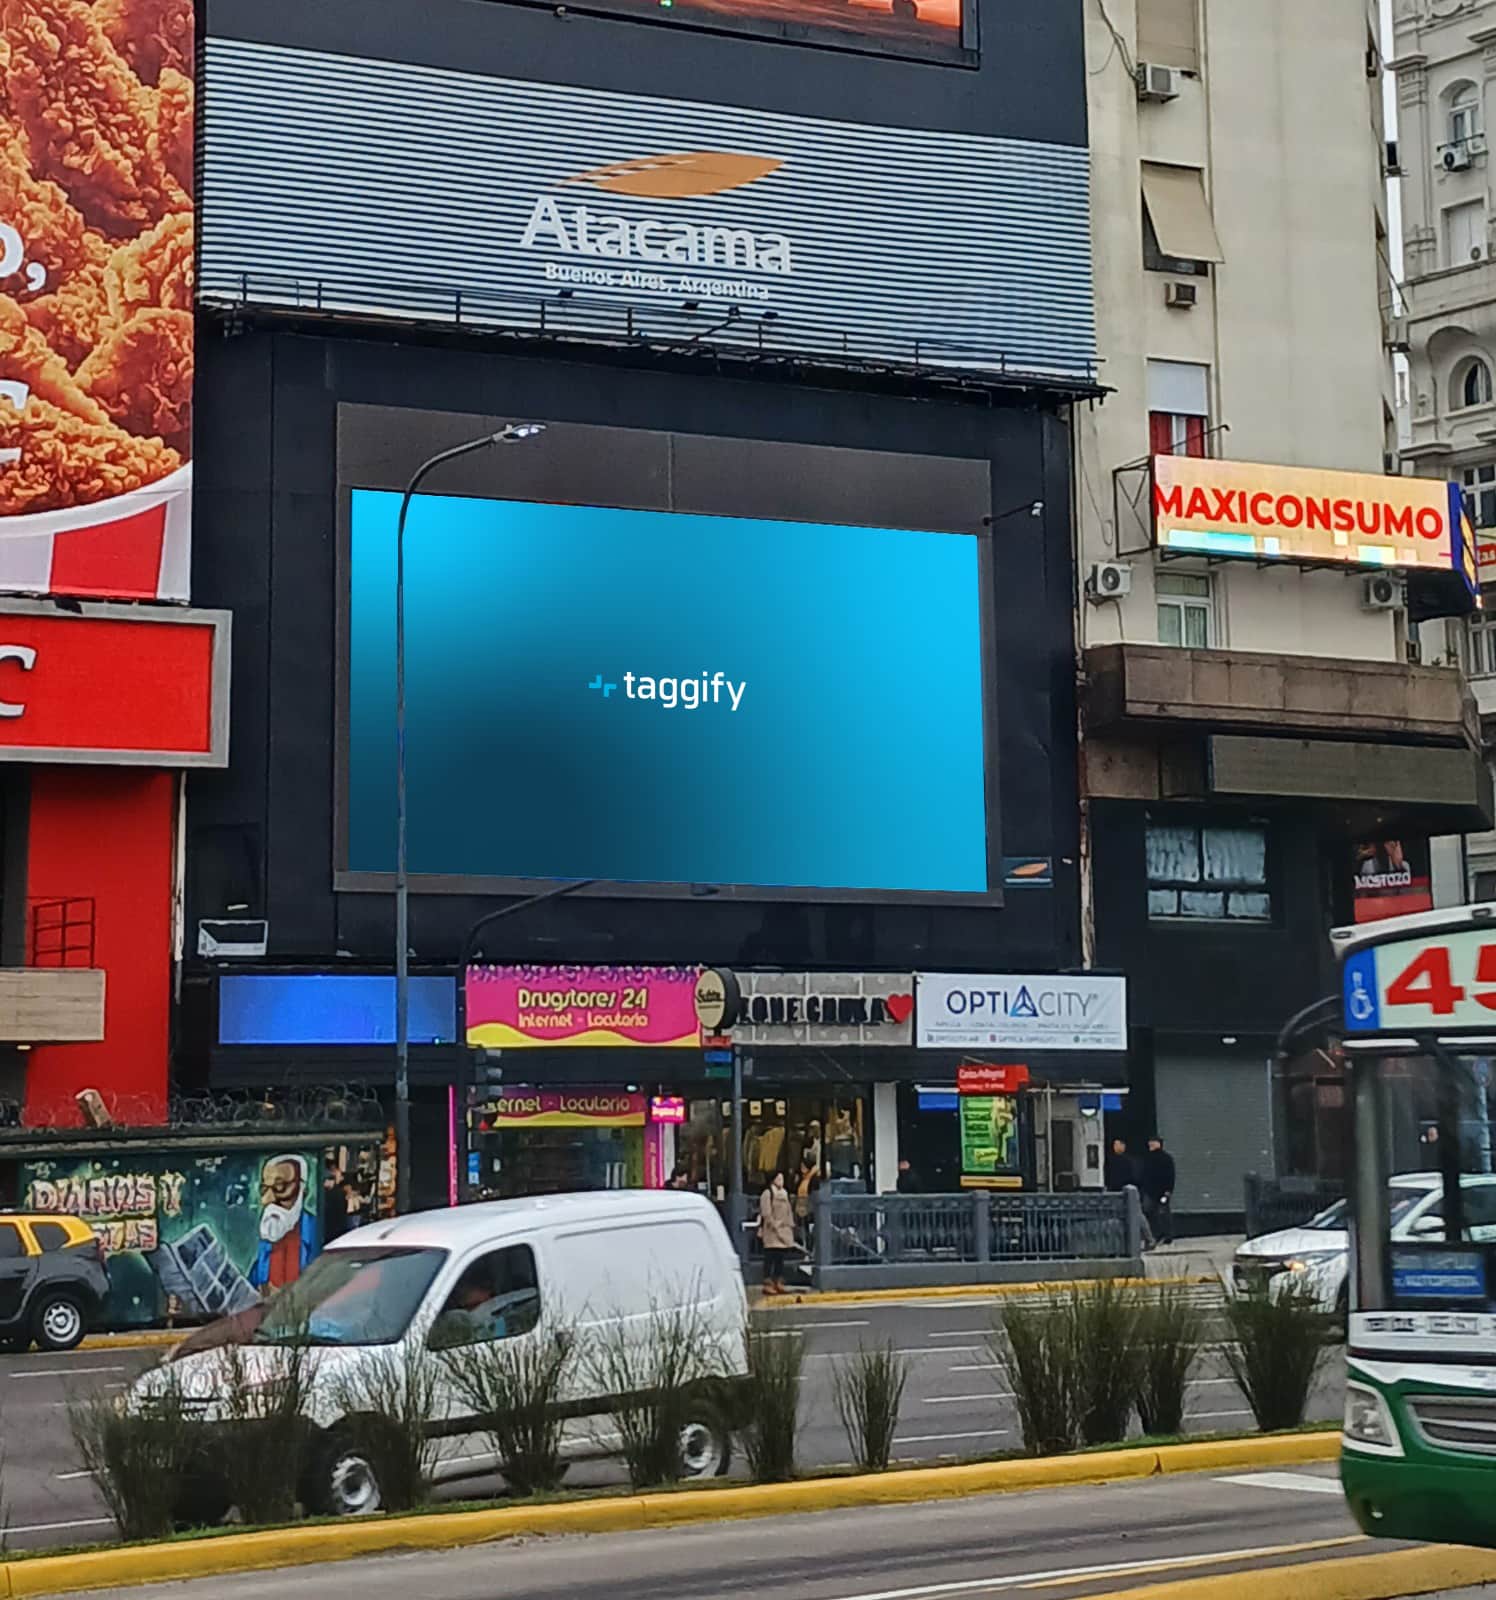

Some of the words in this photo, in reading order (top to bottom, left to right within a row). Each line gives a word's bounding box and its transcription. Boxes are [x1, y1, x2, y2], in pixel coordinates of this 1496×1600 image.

[519, 197, 793, 273] Atacama
[545, 262, 615, 287] Buenos
[621, 269, 674, 293] Aires,
[678, 275, 770, 299] Argentina
[1154, 483, 1444, 540] MAXICONSUMO
[622, 670, 747, 712] taggify
[517, 988, 617, 1012] Drugstores
[621, 988, 649, 1009] 24
[518, 1012, 574, 1028] Internet
[587, 1011, 649, 1028] Locutorio
[560, 1095, 631, 1112] Locutorio
